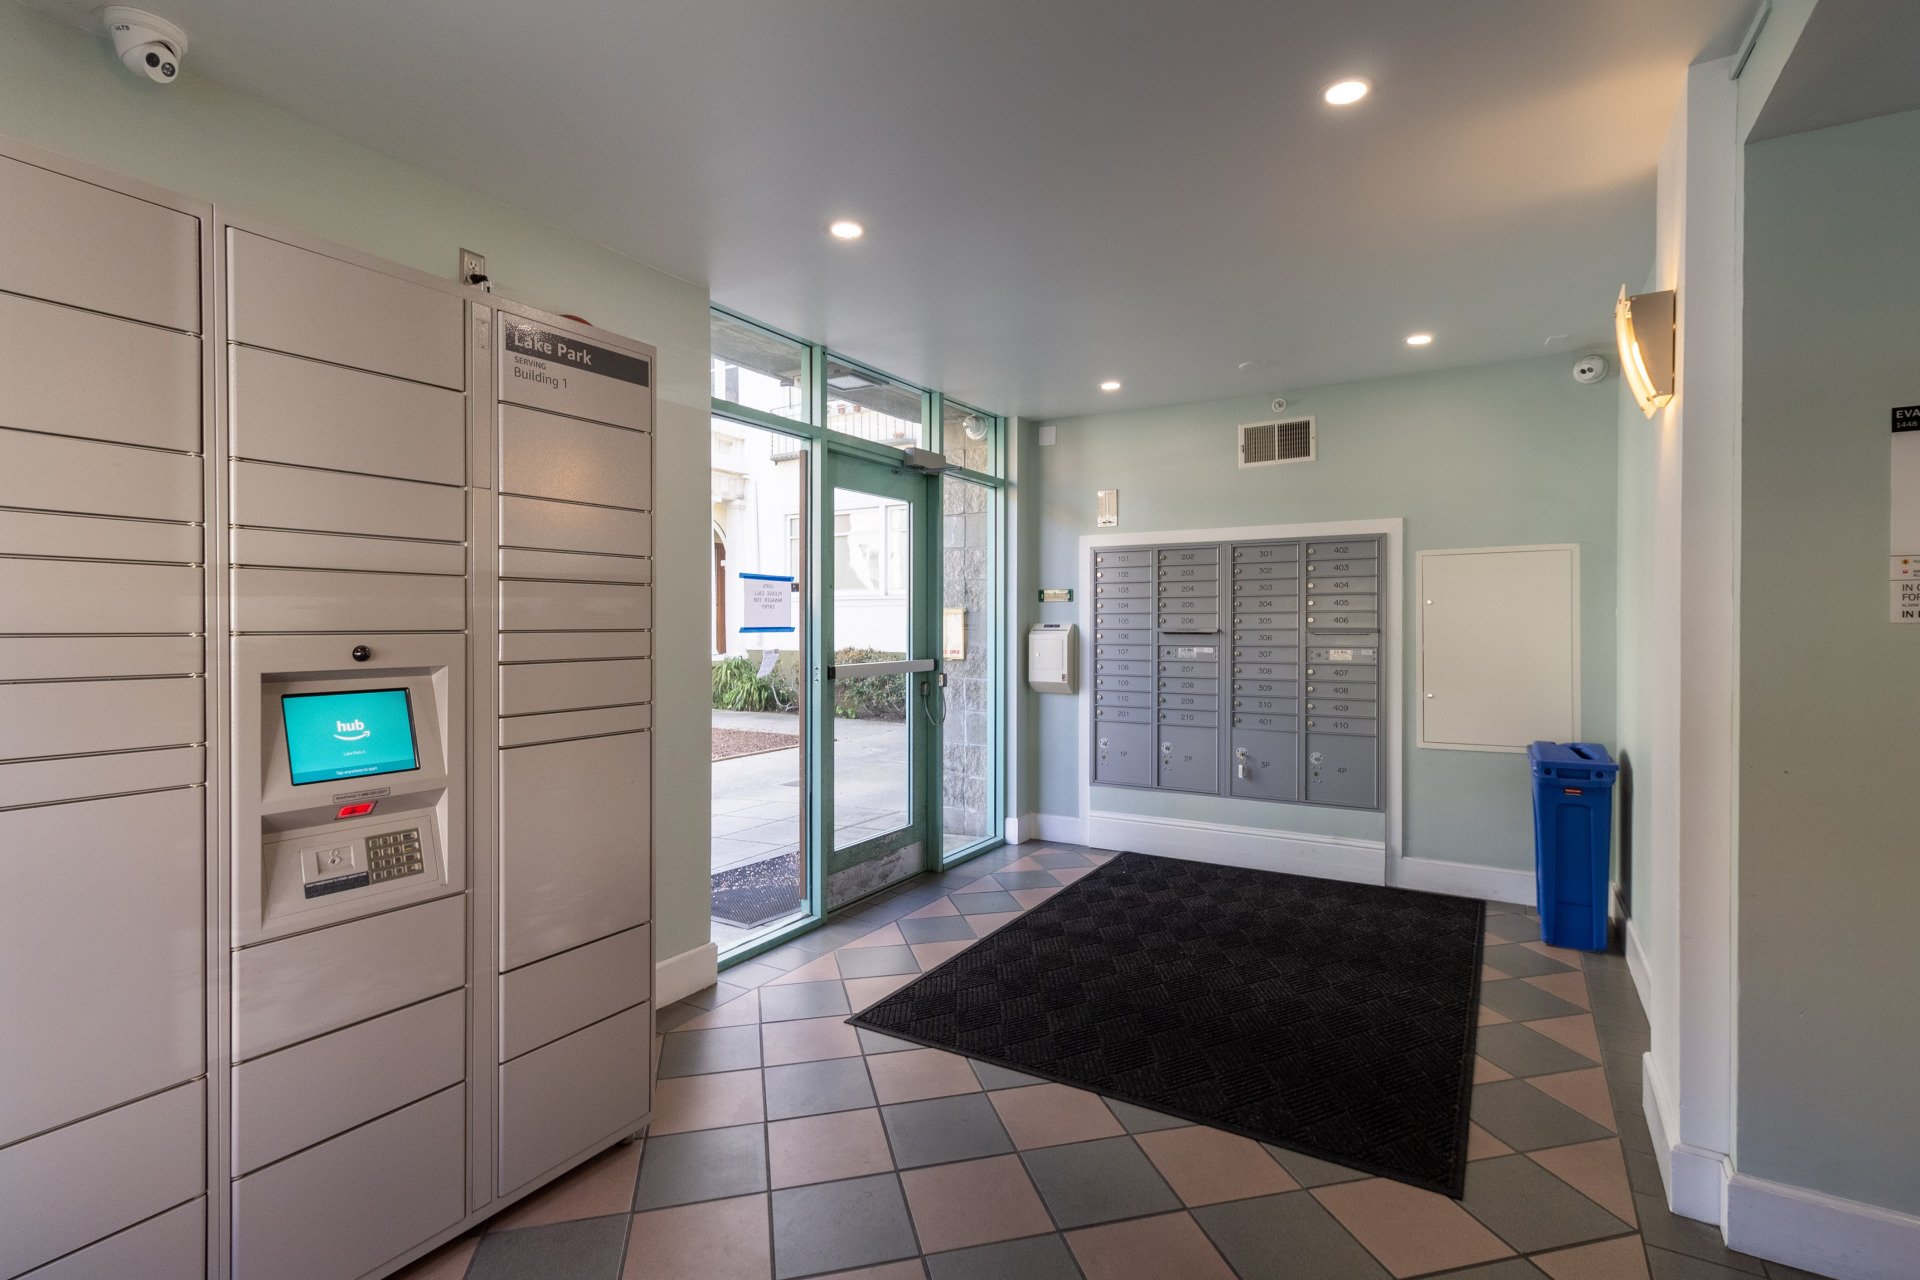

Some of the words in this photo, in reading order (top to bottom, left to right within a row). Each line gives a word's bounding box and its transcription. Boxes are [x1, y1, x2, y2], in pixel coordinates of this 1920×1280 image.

[514, 331, 552, 355] Lake
[557, 343, 592, 366] Park
[514, 356, 547, 370] SERVING
[514, 367, 559, 389] Building
[563, 378, 567, 389] 1
[1896, 408, 1920, 419] EVA
[1334, 546, 1349, 554] 402
[1181, 569, 1195, 577] 203
[1257, 617, 1273, 625] 305
[1258, 650, 1272, 658] 307
[1333, 669, 1349, 677] 407
[1257, 684, 1272, 692] 309
[1333, 686, 1349, 695] 408
[1257, 700, 1272, 709] 310
[1333, 704, 1349, 712] 409
[336, 718, 364, 733] hub
[1333, 721, 1349, 730] 410
